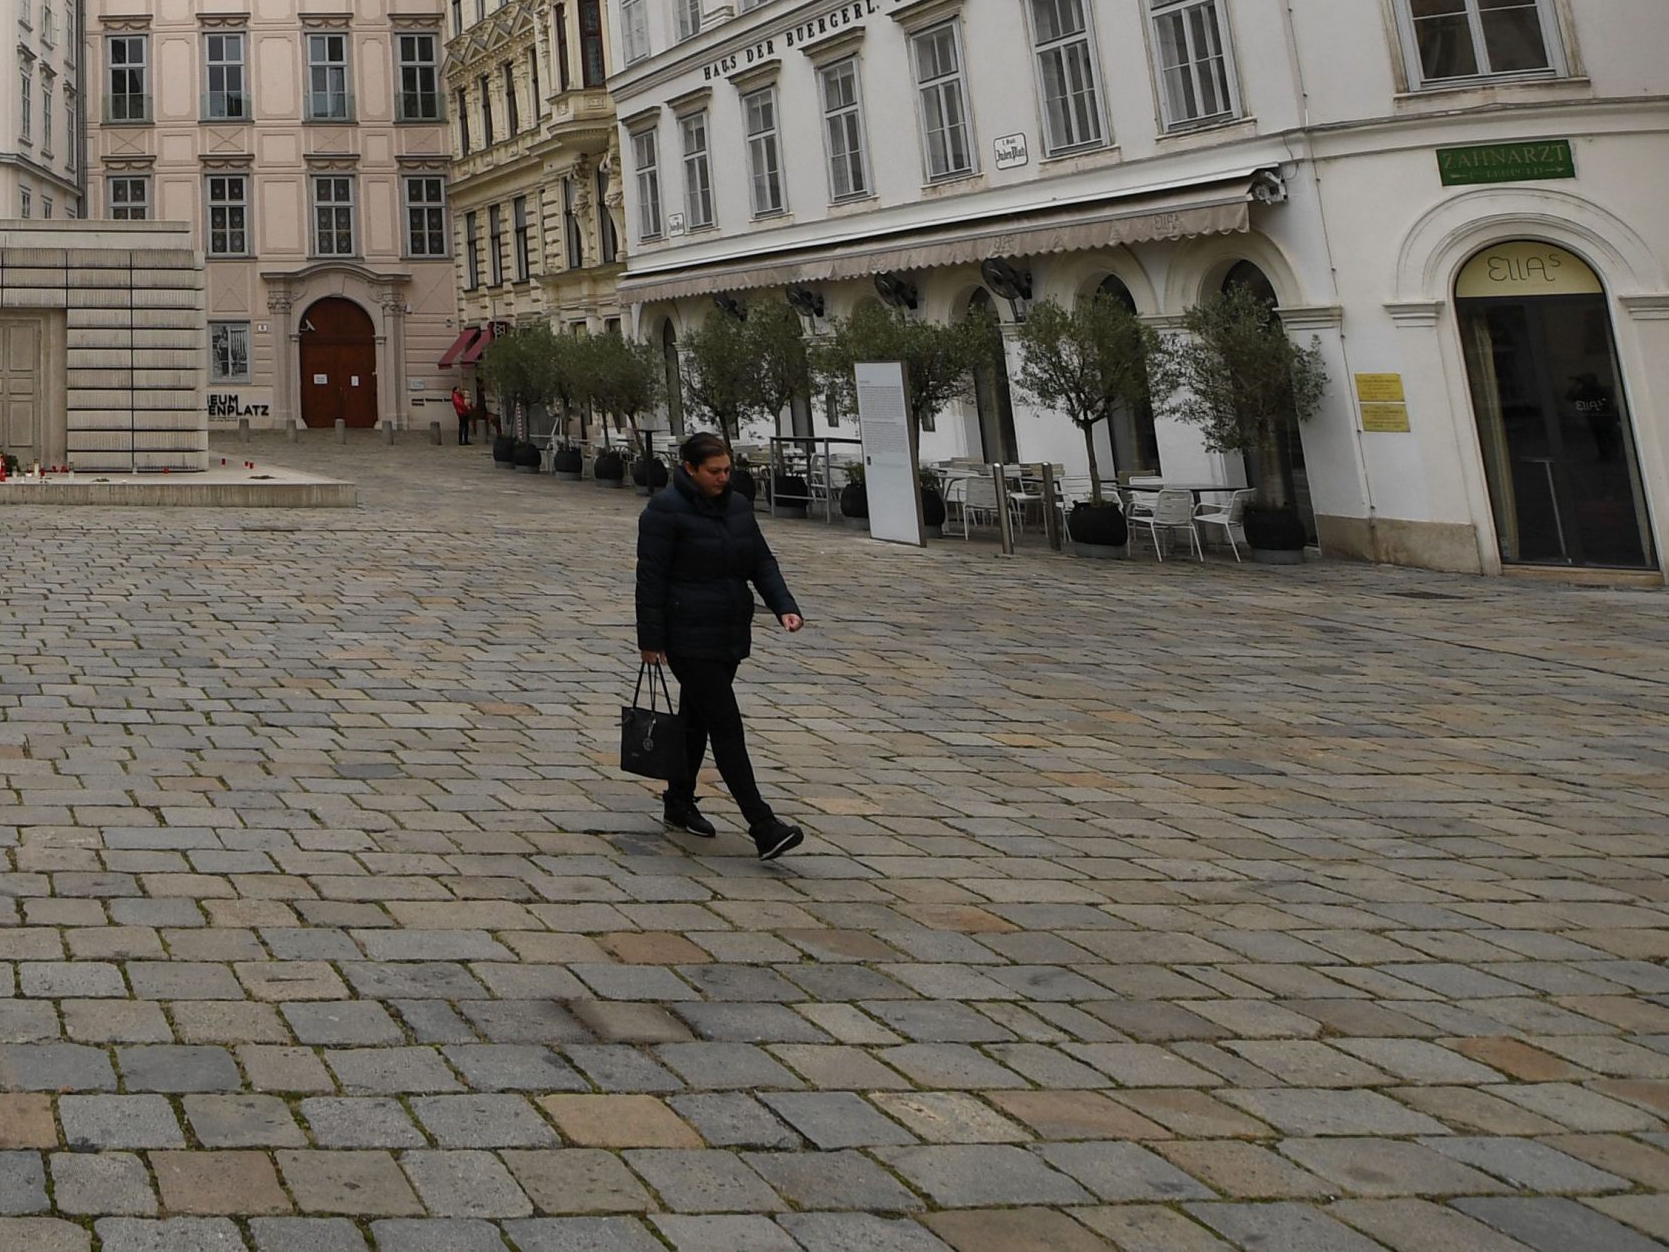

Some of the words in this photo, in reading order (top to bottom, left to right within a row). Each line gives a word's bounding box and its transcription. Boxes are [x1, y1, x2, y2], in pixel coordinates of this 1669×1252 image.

[703, 55, 738, 81] HAUS
[746, 39, 775, 63] DER
[1442, 144, 1566, 169] ZAHNARZT
[207, 394, 238, 405] EUM
